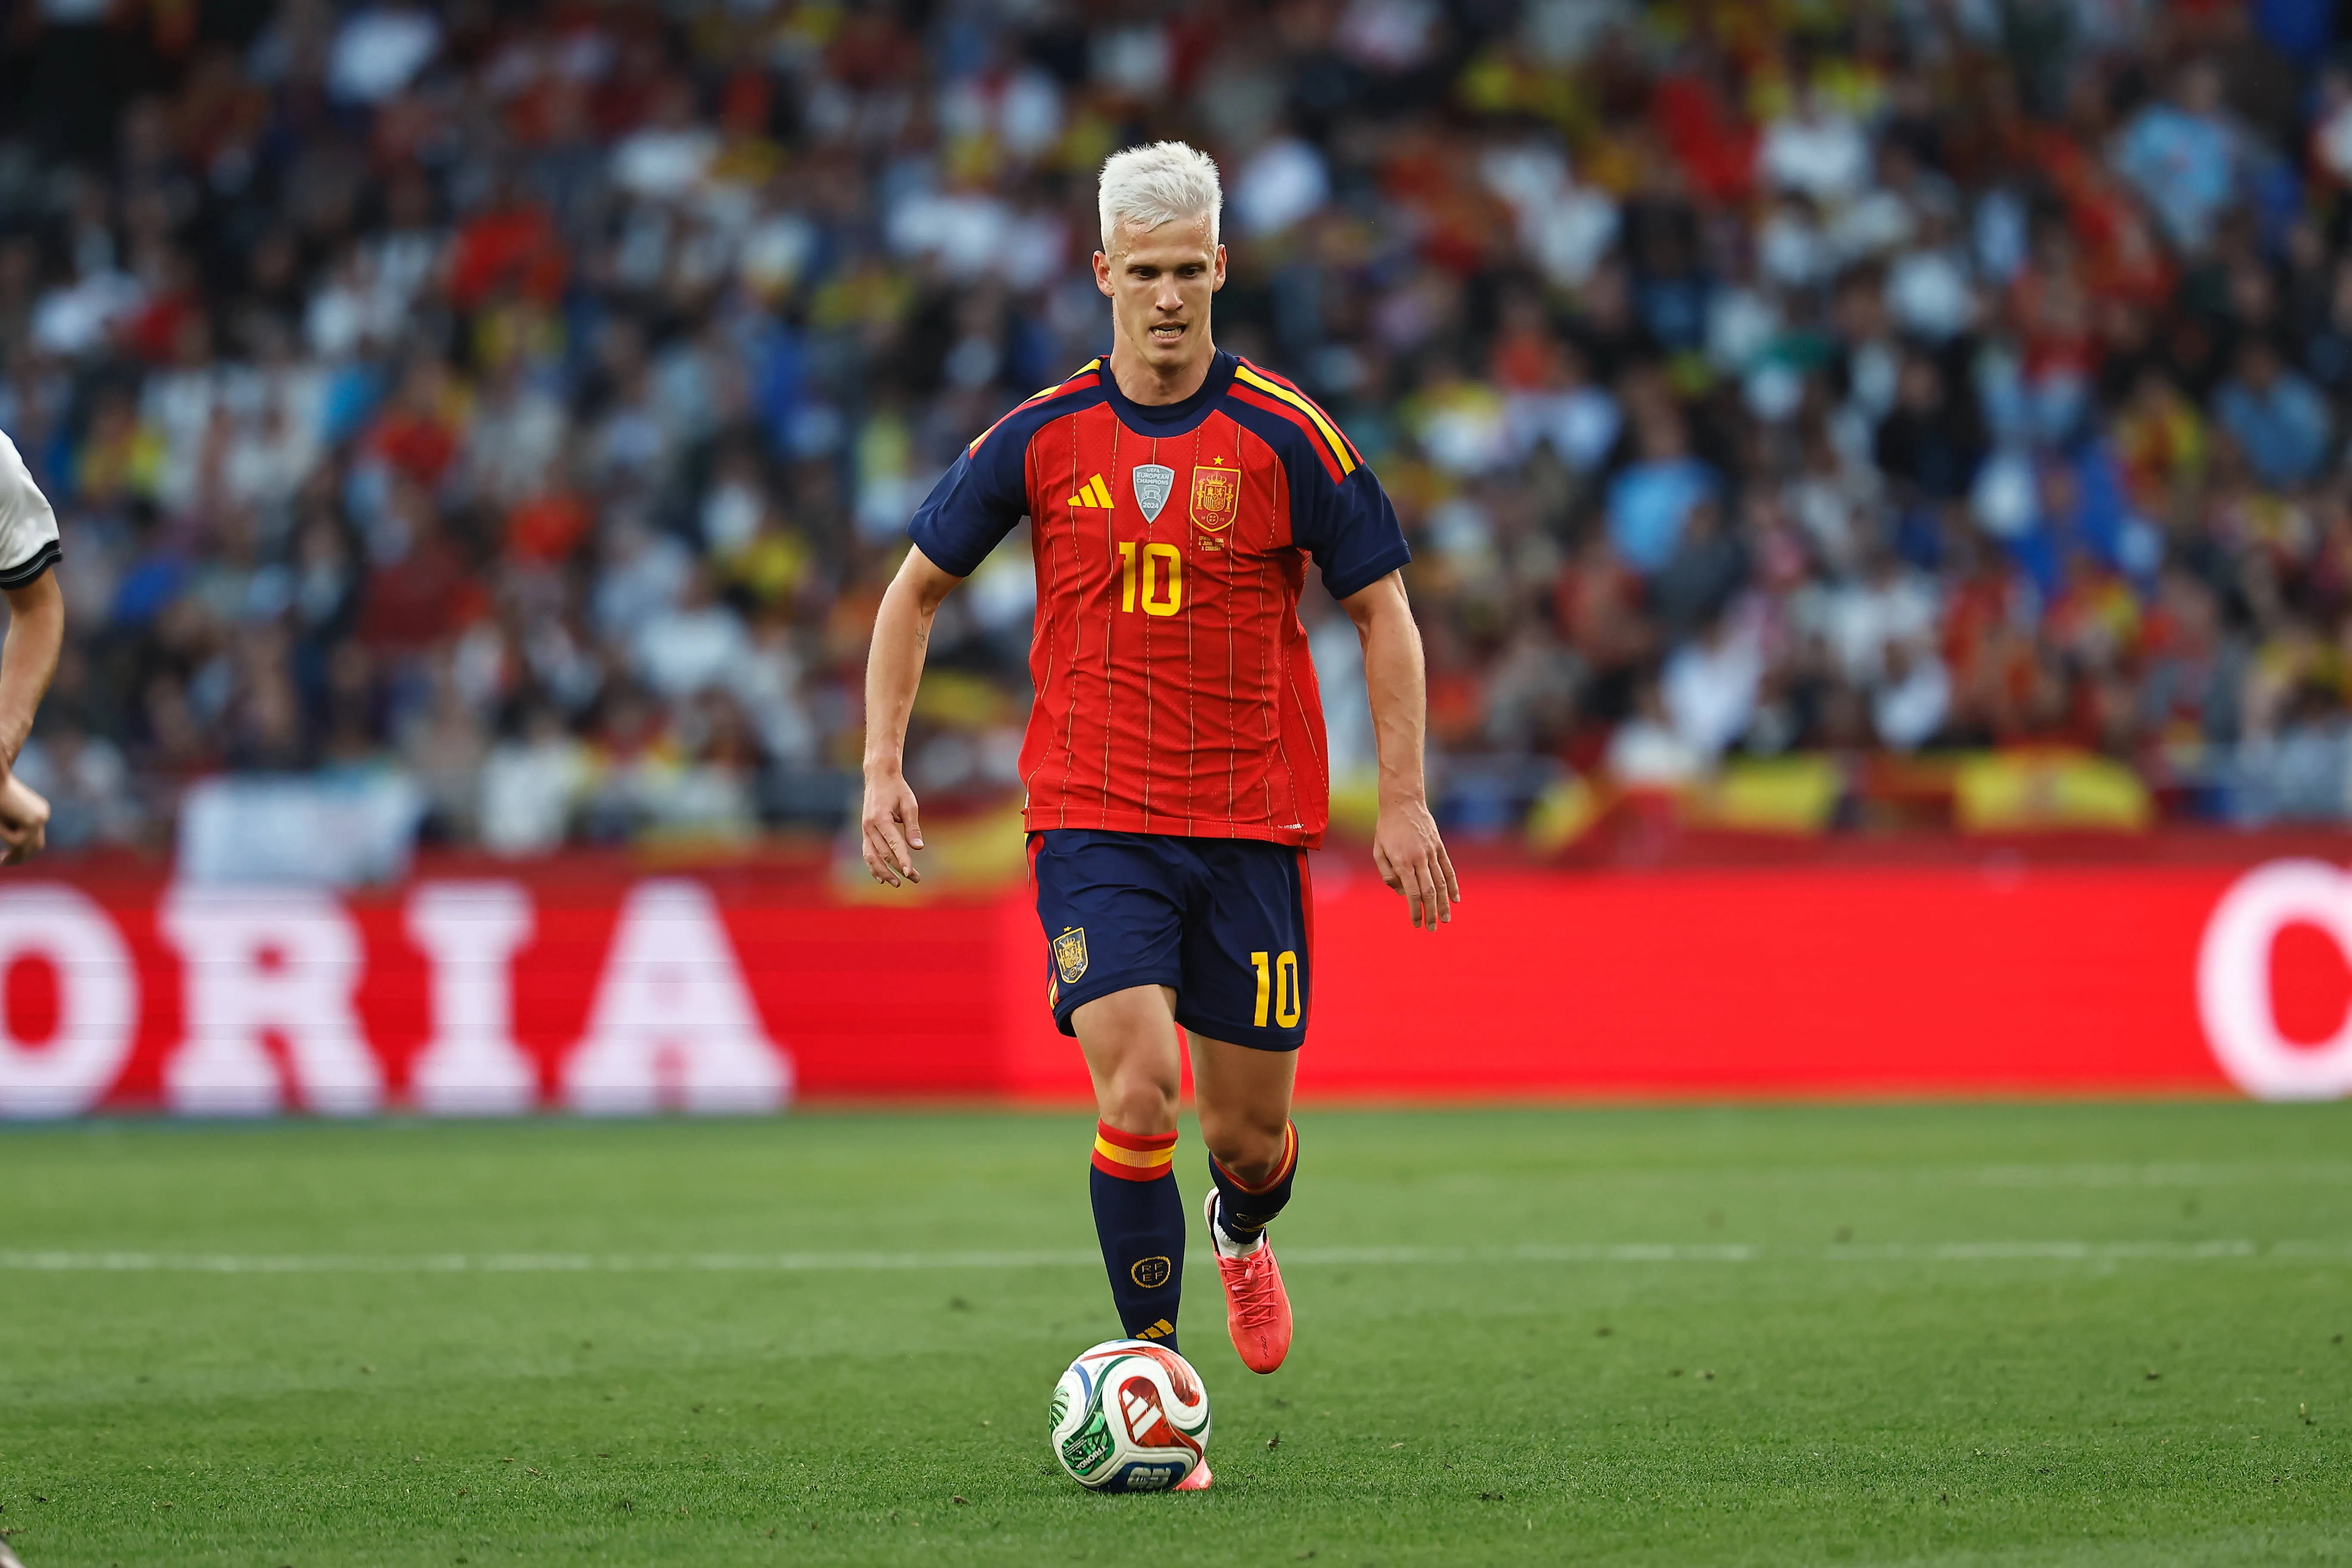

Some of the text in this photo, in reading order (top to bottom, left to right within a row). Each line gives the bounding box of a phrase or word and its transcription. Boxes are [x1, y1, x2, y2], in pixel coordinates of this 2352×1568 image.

[1119, 542, 1182, 617] 10
[1251, 951, 1301, 1029] 10
[1261, 1336, 1269, 1359] F50
[1076, 1445, 1108, 1470] TRIONDA
